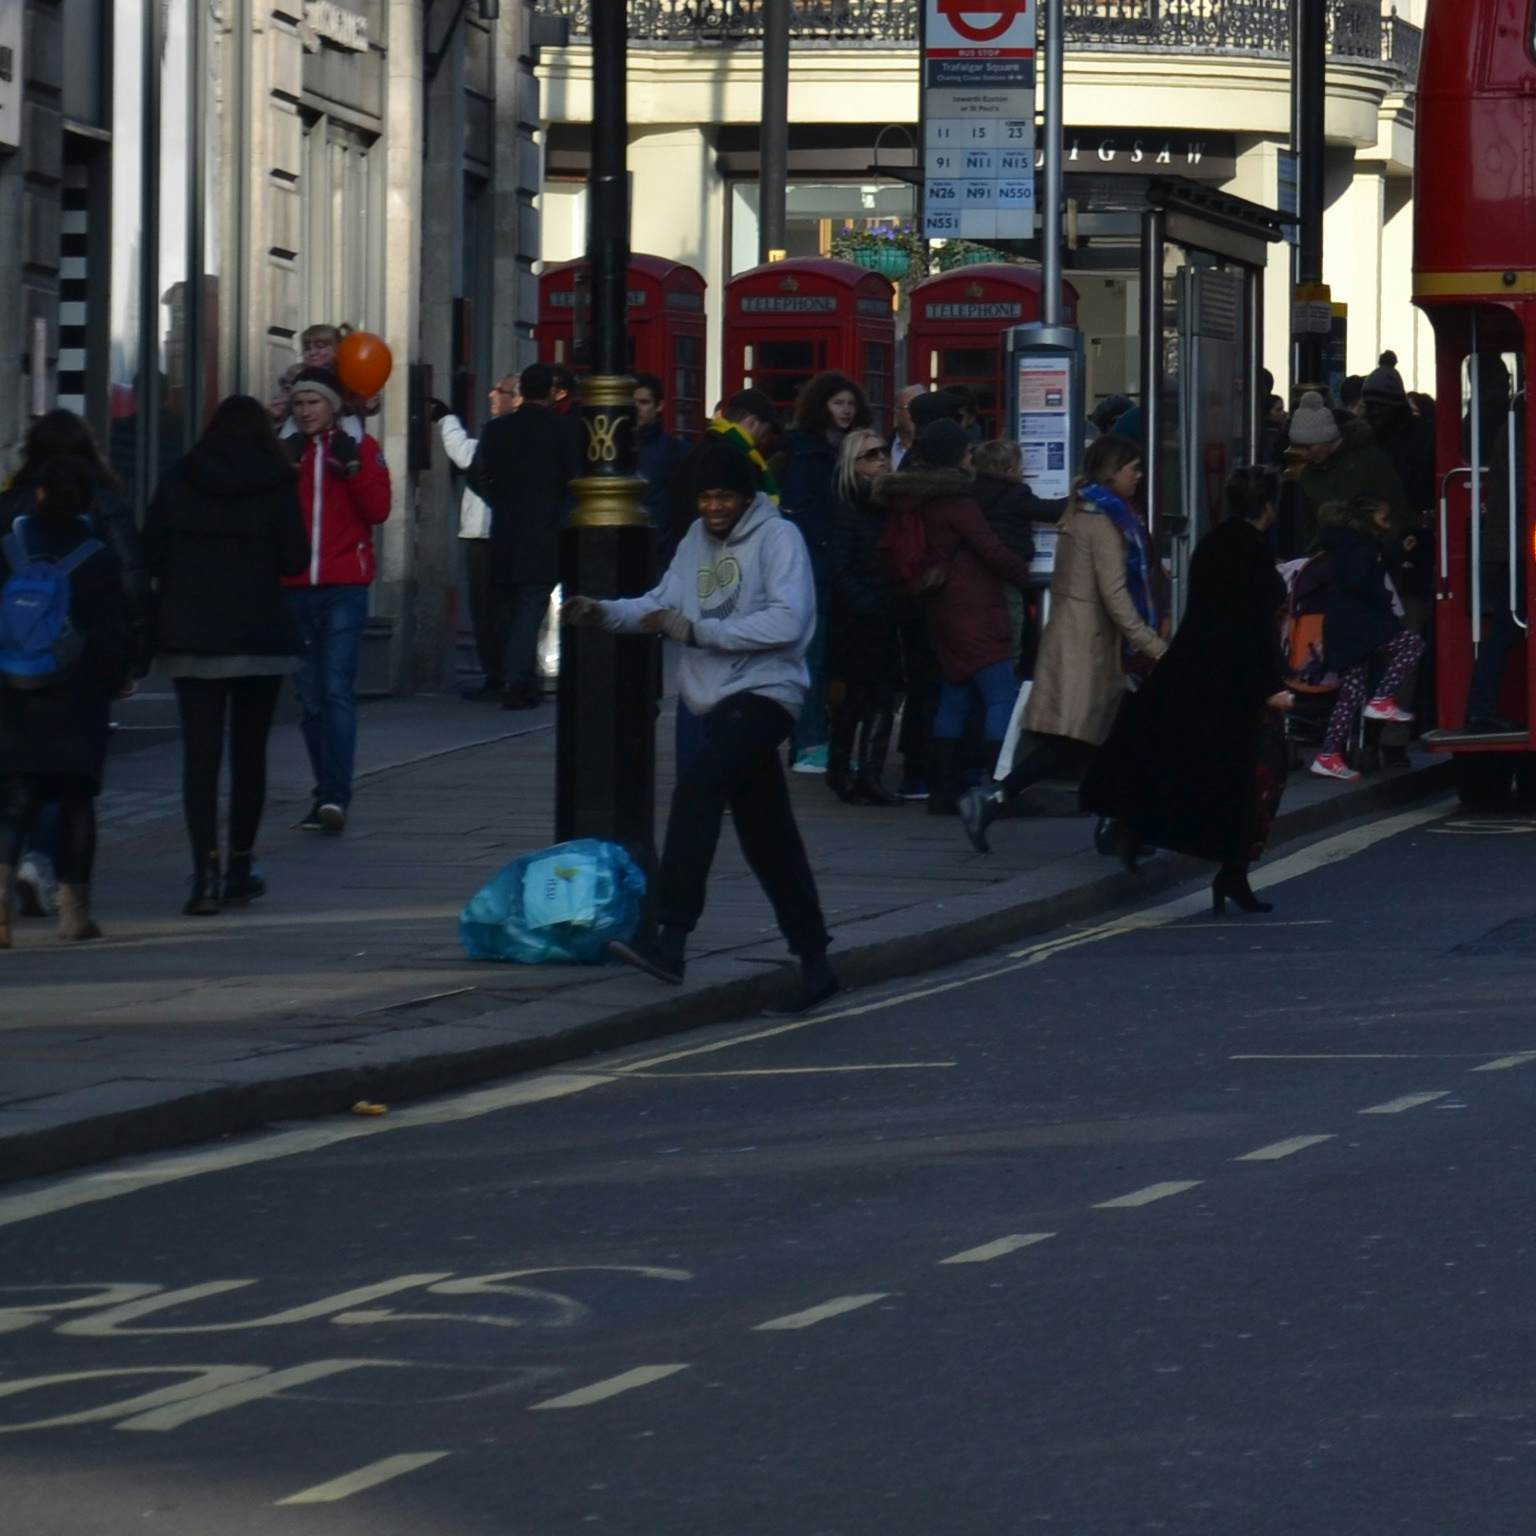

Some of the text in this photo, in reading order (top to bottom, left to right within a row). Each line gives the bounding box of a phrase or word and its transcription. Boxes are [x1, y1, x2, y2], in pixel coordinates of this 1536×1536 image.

[958, 49, 1000, 57] BUS STOP
[941, 63, 1020, 74] Trafalgar Square
[938, 127, 1024, 139] 11 15 23
[936, 157, 1029, 169] 91 N11 N15
[929, 188, 1032, 199] N26 N91 N550
[926, 218, 959, 230] N551
[743, 297, 836, 312] TELEPHONE
[929, 304, 1021, 318] TELEPHONE
